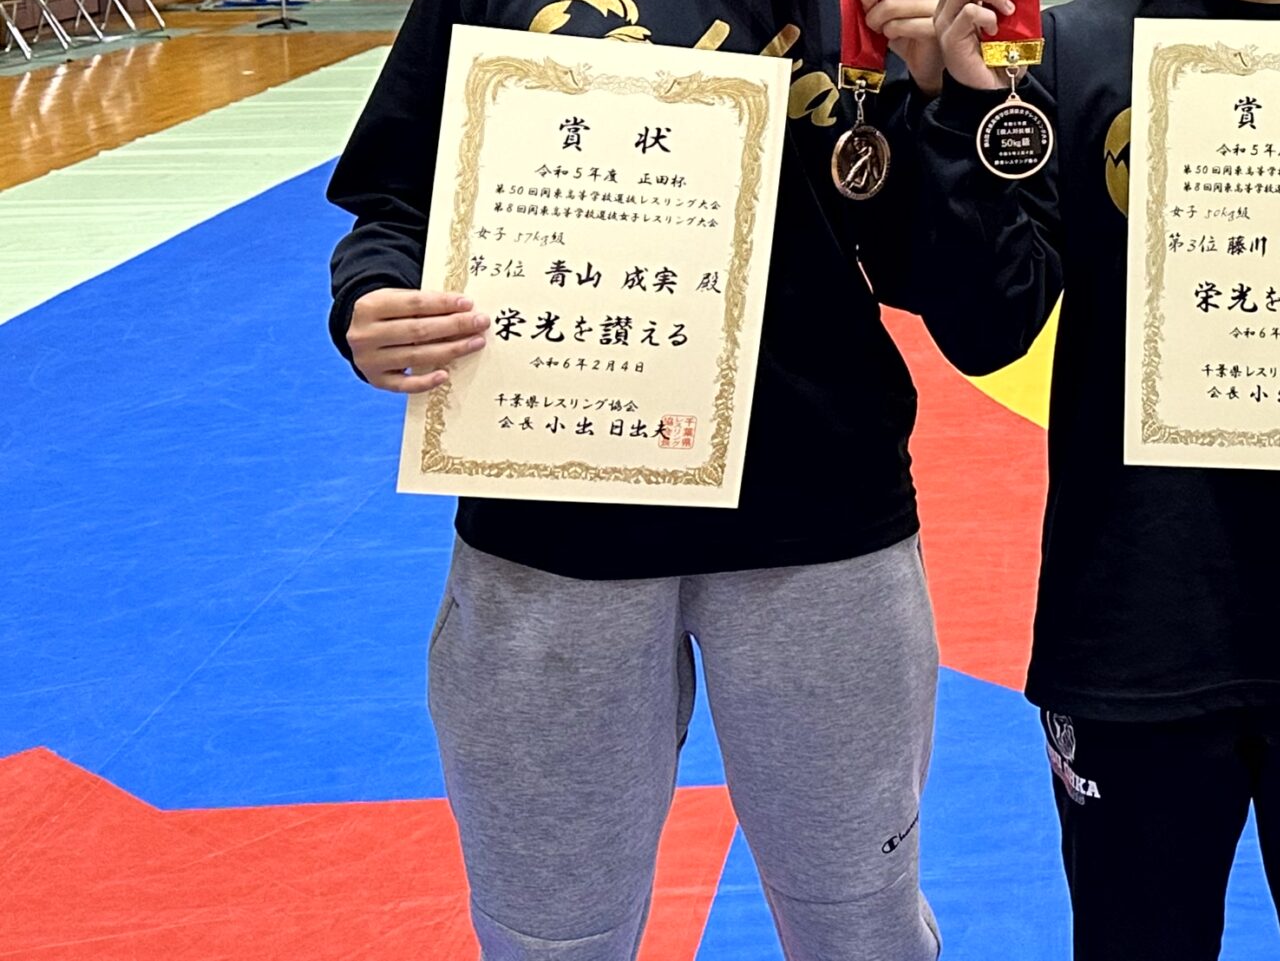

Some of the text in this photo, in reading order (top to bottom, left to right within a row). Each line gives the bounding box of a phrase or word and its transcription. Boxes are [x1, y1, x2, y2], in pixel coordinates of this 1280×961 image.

[534, 164, 687, 189] 令和5年度 正田杯
[1168, 232, 1218, 253] 第3位
[470, 255, 526, 278] 第3位
[545, 259, 602, 288] 青山
[529, 356, 646, 374] 令和6年2月4日
[494, 393, 639, 413] 千葉県レスリング協会
